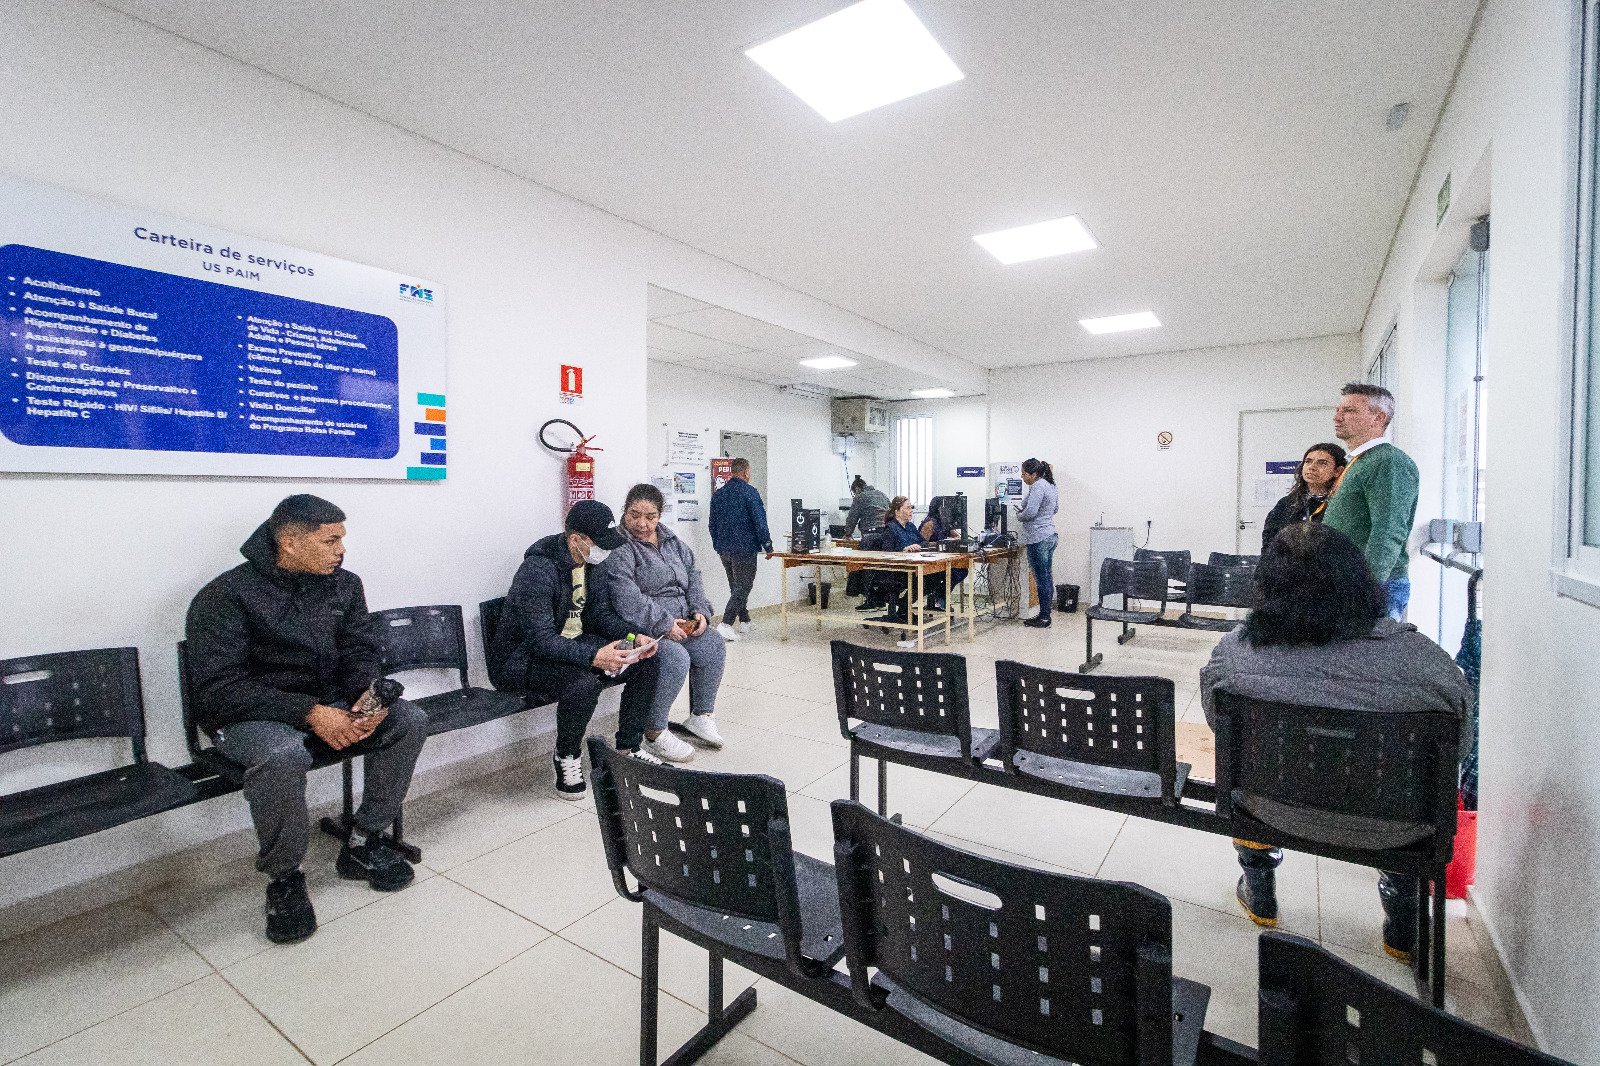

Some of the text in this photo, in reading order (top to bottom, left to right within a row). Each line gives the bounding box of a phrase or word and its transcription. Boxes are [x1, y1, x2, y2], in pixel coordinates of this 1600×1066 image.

[133, 226, 315, 277] Carteira de serviços
[202, 261, 260, 281] US PAIM
[23, 277, 100, 296] Acolhimento
[23, 292, 76, 306] Atenção
[88, 302, 124, 314] Saúde
[126, 307, 158, 320] Bucal
[24, 307, 149, 332] Acompanhamento de
[247, 315, 283, 328] Atenção
[291, 322, 317, 333] Saúde
[333, 330, 358, 340] Ciclos
[24, 317, 98, 334] Hipertensão
[110, 328, 158, 342] Diabetes
[247, 324, 259, 332] de
[260, 325, 280, 335] Vida
[25, 331, 96, 348] Assistência
[247, 331, 276, 342] Adulto
[285, 337, 315, 348] Pessoa
[316, 341, 338, 352] Idosa
[36, 344, 87, 357] parceiro
[247, 343, 322, 361] Exame Preventivo
[25, 357, 131, 375] Teste de Gravidez
[247, 364, 282, 375] Vacinas
[25, 371, 104, 387] Dispensação
[106, 380, 121, 388] de
[123, 380, 190, 394] Preservativo
[26, 382, 118, 397] Contraceptivos
[248, 376, 272, 386] Teste
[286, 382, 319, 391] pezinho
[248, 389, 290, 400] Curativos
[300, 395, 339, 405] pequenos
[26, 396, 60, 407] Teste
[63, 399, 106, 410] Rápido
[174, 408, 216, 418] Hepatite
[26, 406, 91, 419] Hepatite C
[248, 401, 316, 414] Visita Domiciliar
[249, 414, 324, 427] Acompanhamento
[262, 423, 304, 433] Programa
[304, 426, 328, 435] Bolsa
